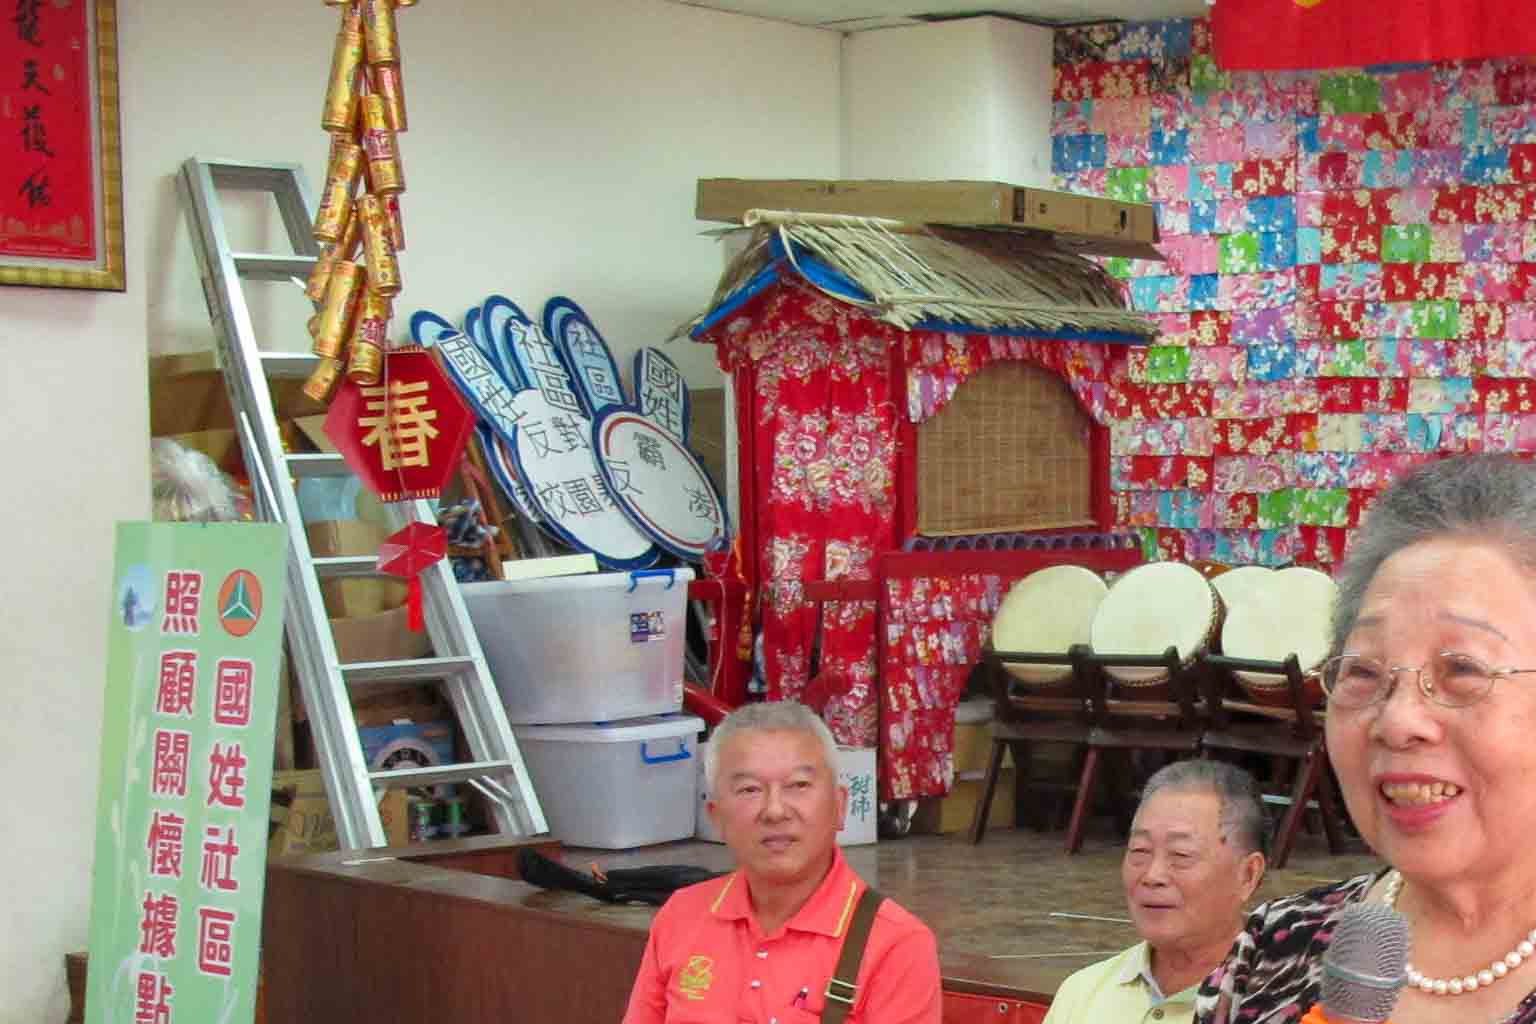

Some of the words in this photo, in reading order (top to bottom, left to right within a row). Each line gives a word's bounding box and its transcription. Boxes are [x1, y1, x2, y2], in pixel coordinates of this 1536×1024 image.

[357, 380, 440, 469] 春
[198, 658, 254, 977] 國姓社區
